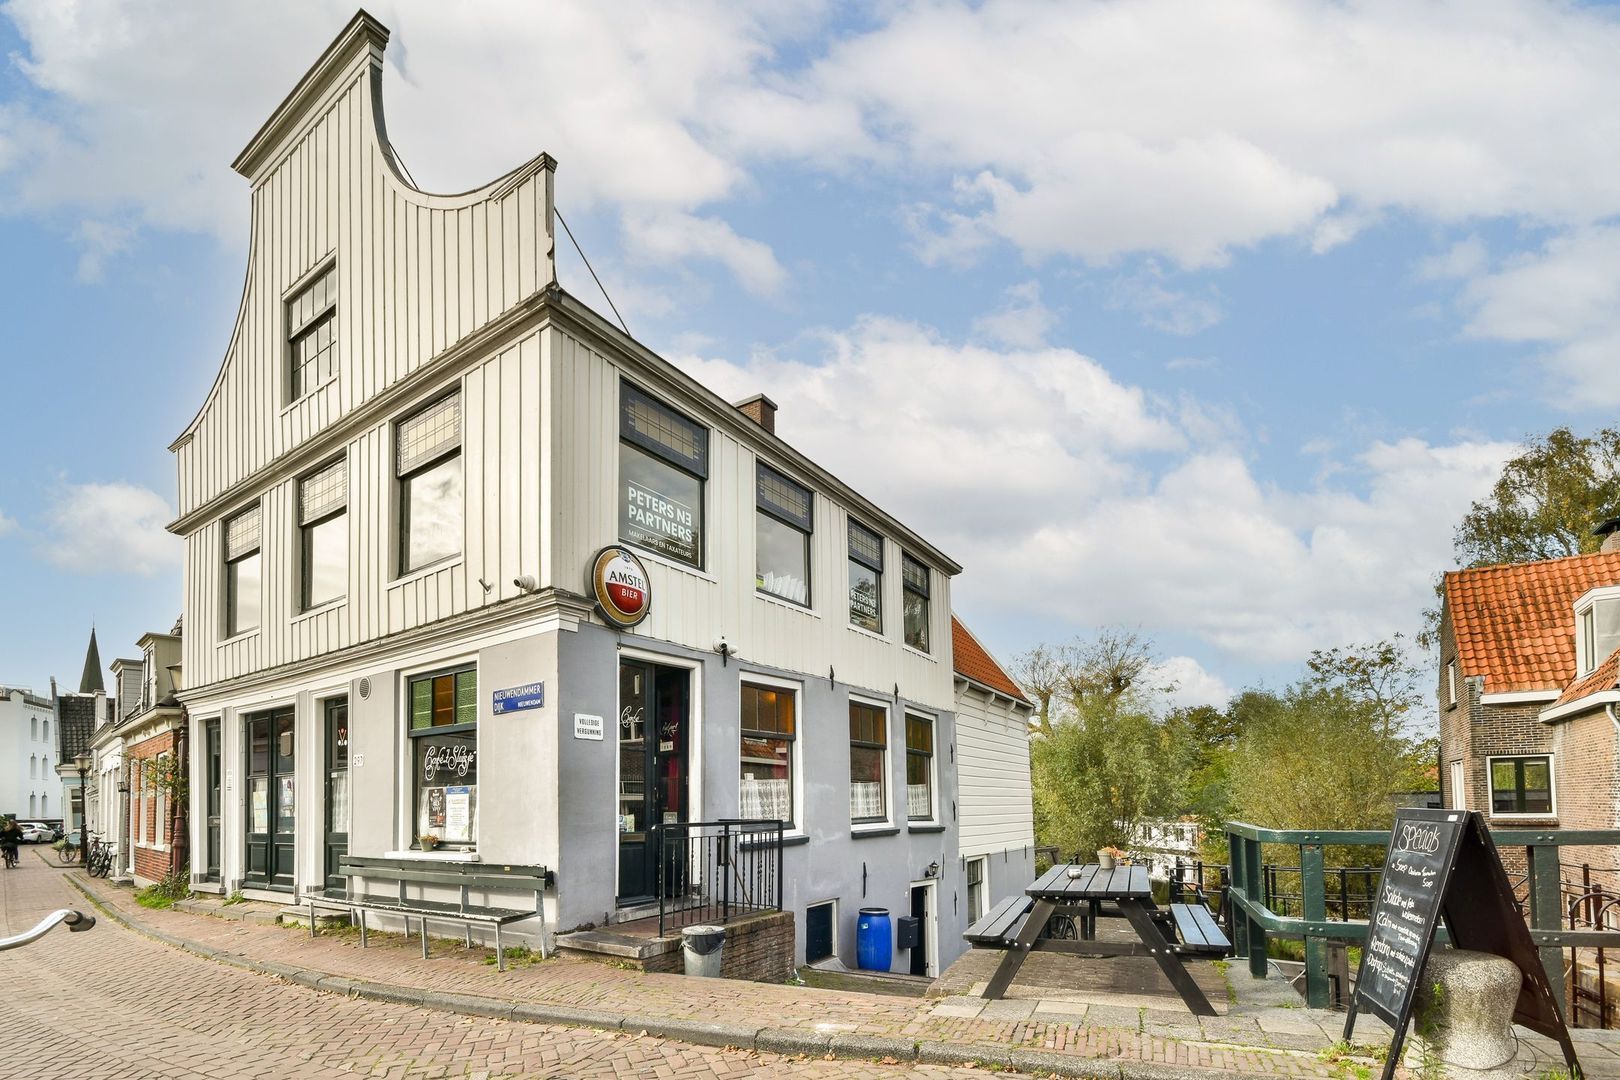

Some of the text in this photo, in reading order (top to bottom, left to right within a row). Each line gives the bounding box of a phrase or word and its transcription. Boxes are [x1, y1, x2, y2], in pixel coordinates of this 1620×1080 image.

[628, 486, 674, 519] PETERS
[628, 504, 693, 543] PARTNERS
[666, 543, 692, 559] TAXATEURS
[609, 570, 646, 591] AMSTEL
[621, 588, 638, 600] BIER
[850, 599, 877, 616] PARTNERS
[494, 684, 541, 700] NIEUWENDAMMER
[517, 699, 541, 708] NIEUWENDAM
[578, 718, 600, 727] VOLLEDIGE
[576, 727, 602, 736] VERGUNNING
